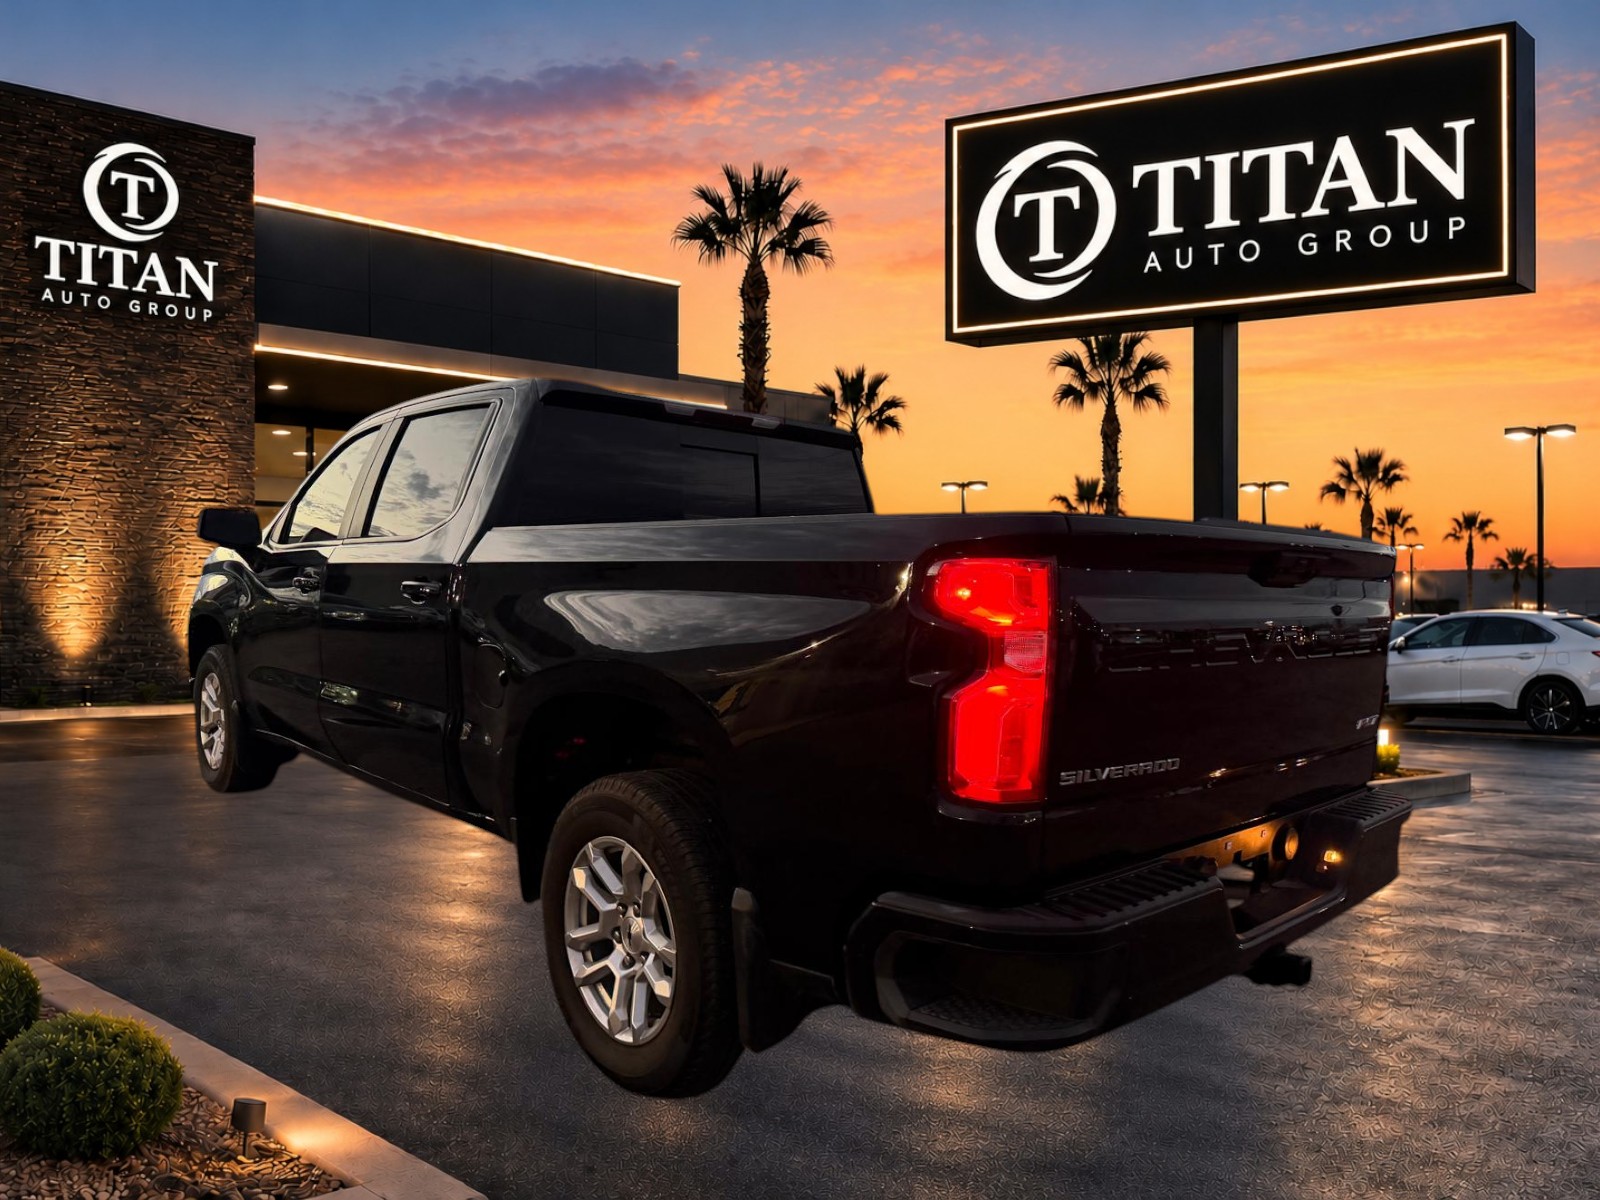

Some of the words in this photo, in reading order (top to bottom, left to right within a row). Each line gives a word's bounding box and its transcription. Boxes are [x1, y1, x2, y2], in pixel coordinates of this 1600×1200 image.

[110, 170, 155, 221] T
[1132, 118, 1476, 237] TITAN
[1013, 185, 1081, 263] T
[1143, 239, 1261, 274] AUTO
[1298, 216, 1467, 257] GROUP
[34, 235, 219, 302] TITAN
[41, 287, 111, 309] AUTO
[128, 299, 213, 322] GROUP
[1059, 757, 1181, 786] SILVERADO
